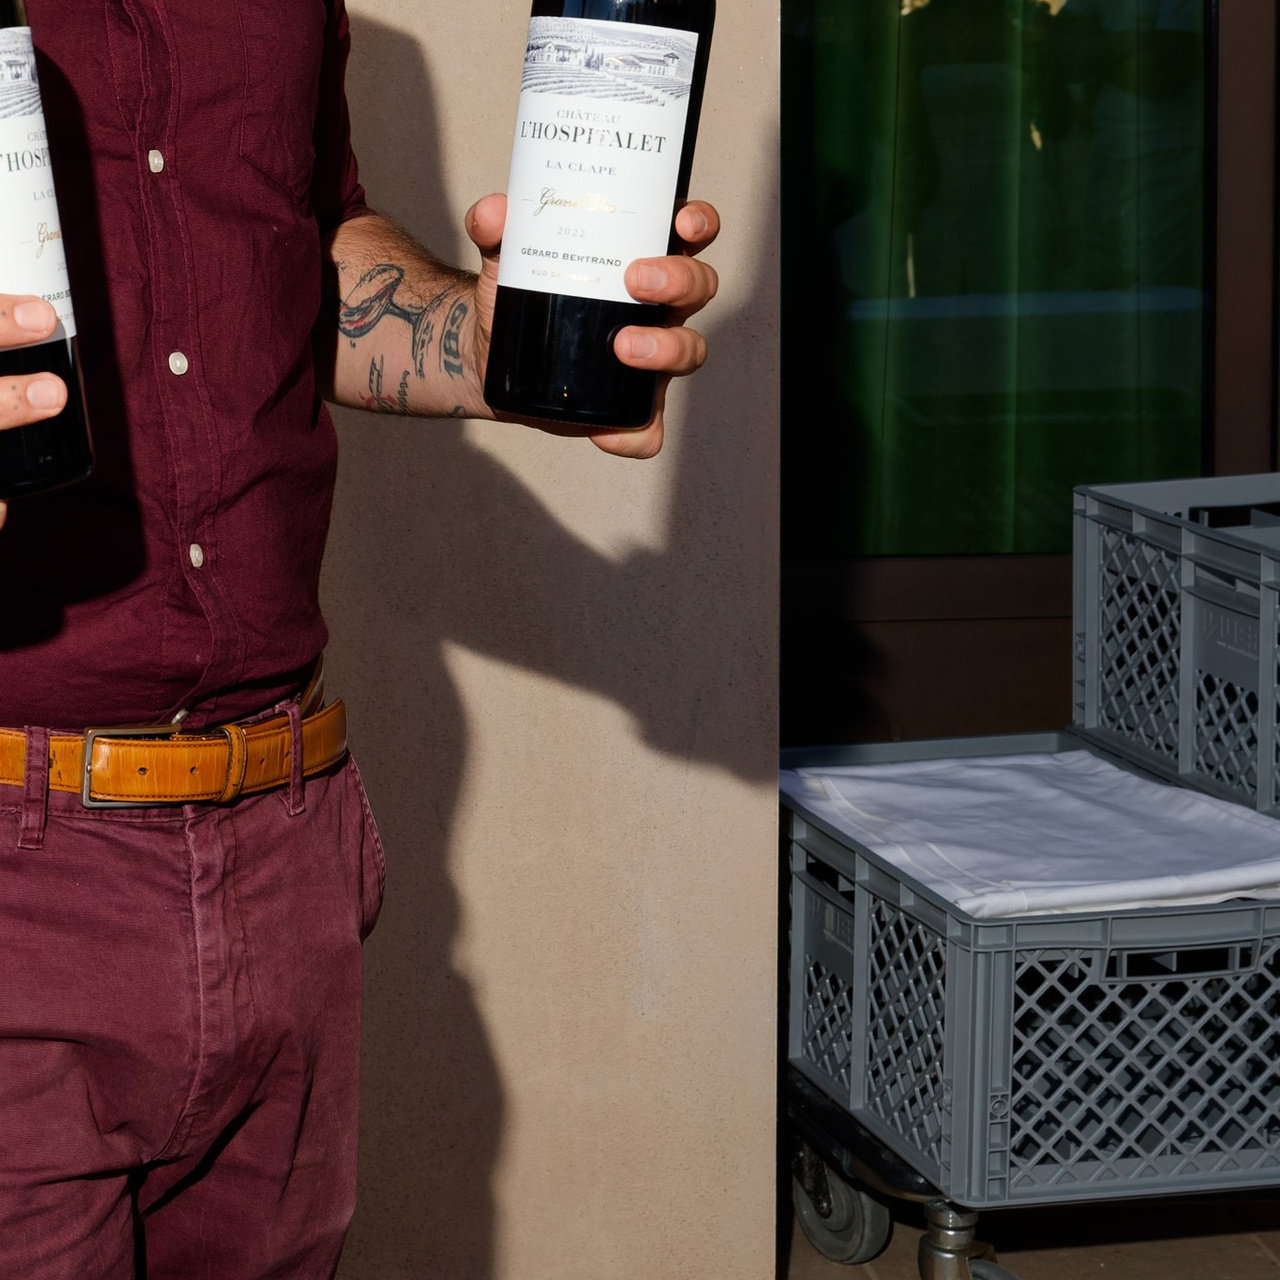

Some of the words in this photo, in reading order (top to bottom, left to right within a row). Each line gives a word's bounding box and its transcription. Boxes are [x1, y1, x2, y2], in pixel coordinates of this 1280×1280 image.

[520, 120, 667, 154] L'HOSPITALET
[545, 159, 563, 171] LA
[567, 161, 618, 177] CLAPE
[557, 226, 587, 239] 2022
[520, 246, 560, 260] GÉRARD
[561, 252, 623, 268] BERTRAND
